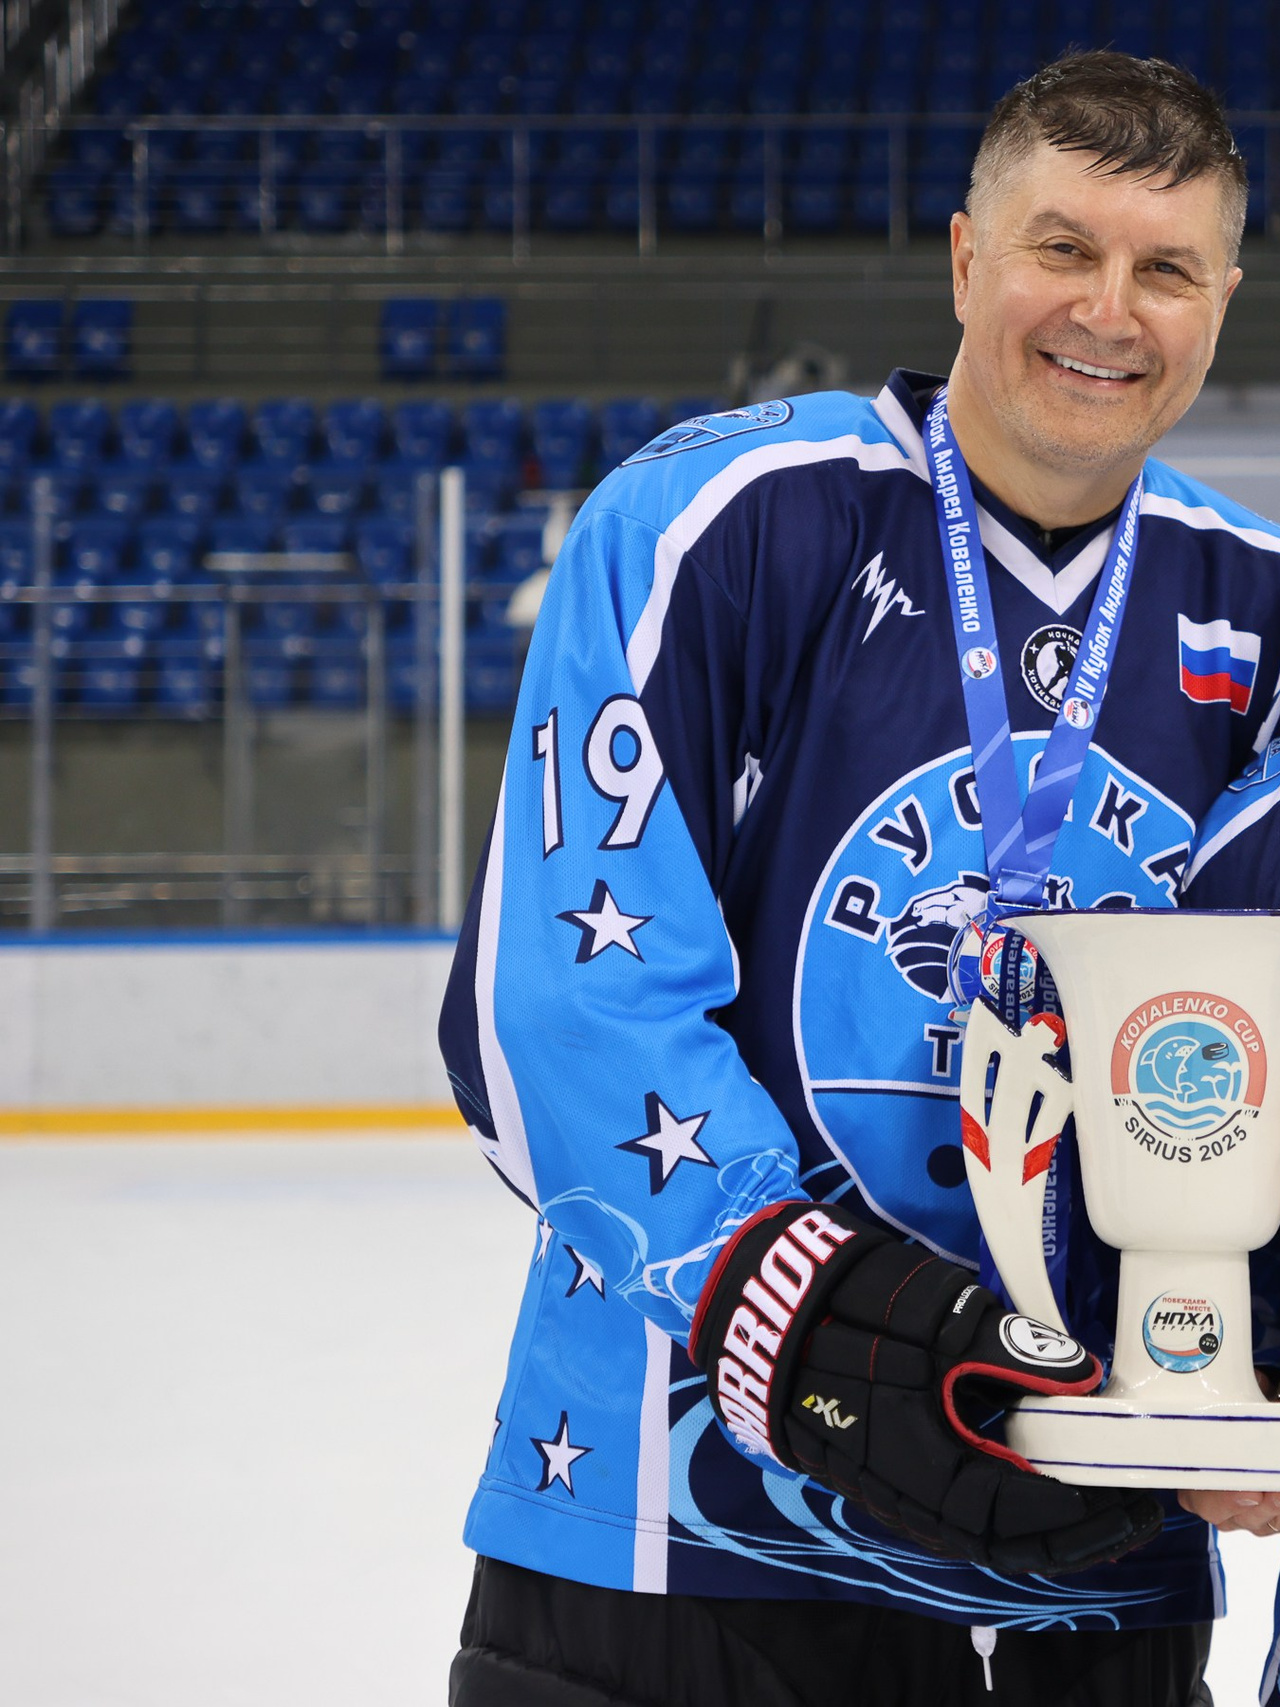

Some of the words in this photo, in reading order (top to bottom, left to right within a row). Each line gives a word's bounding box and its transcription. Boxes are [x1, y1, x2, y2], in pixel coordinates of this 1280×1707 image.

[933, 448, 963, 520] Андрея
[947, 521, 981, 633] Коваленко
[1098, 553, 1130, 625] Андрея
[1047, 631, 1080, 646] НОЧНА
[1079, 620, 1115, 682] Кубок
[1074, 676, 1096, 700] IV
[532, 692, 667, 862] 19
[1120, 997, 1229, 1051] KOVALENKO
[1233, 1018, 1260, 1053] CUP
[1124, 1116, 1192, 1163] SIRIUS
[1199, 1125, 1247, 1162] 2025
[1153, 1311, 1214, 1326] НПХЛ
[1162, 1297, 1207, 1305] ПОБЕЖДАЕМ
